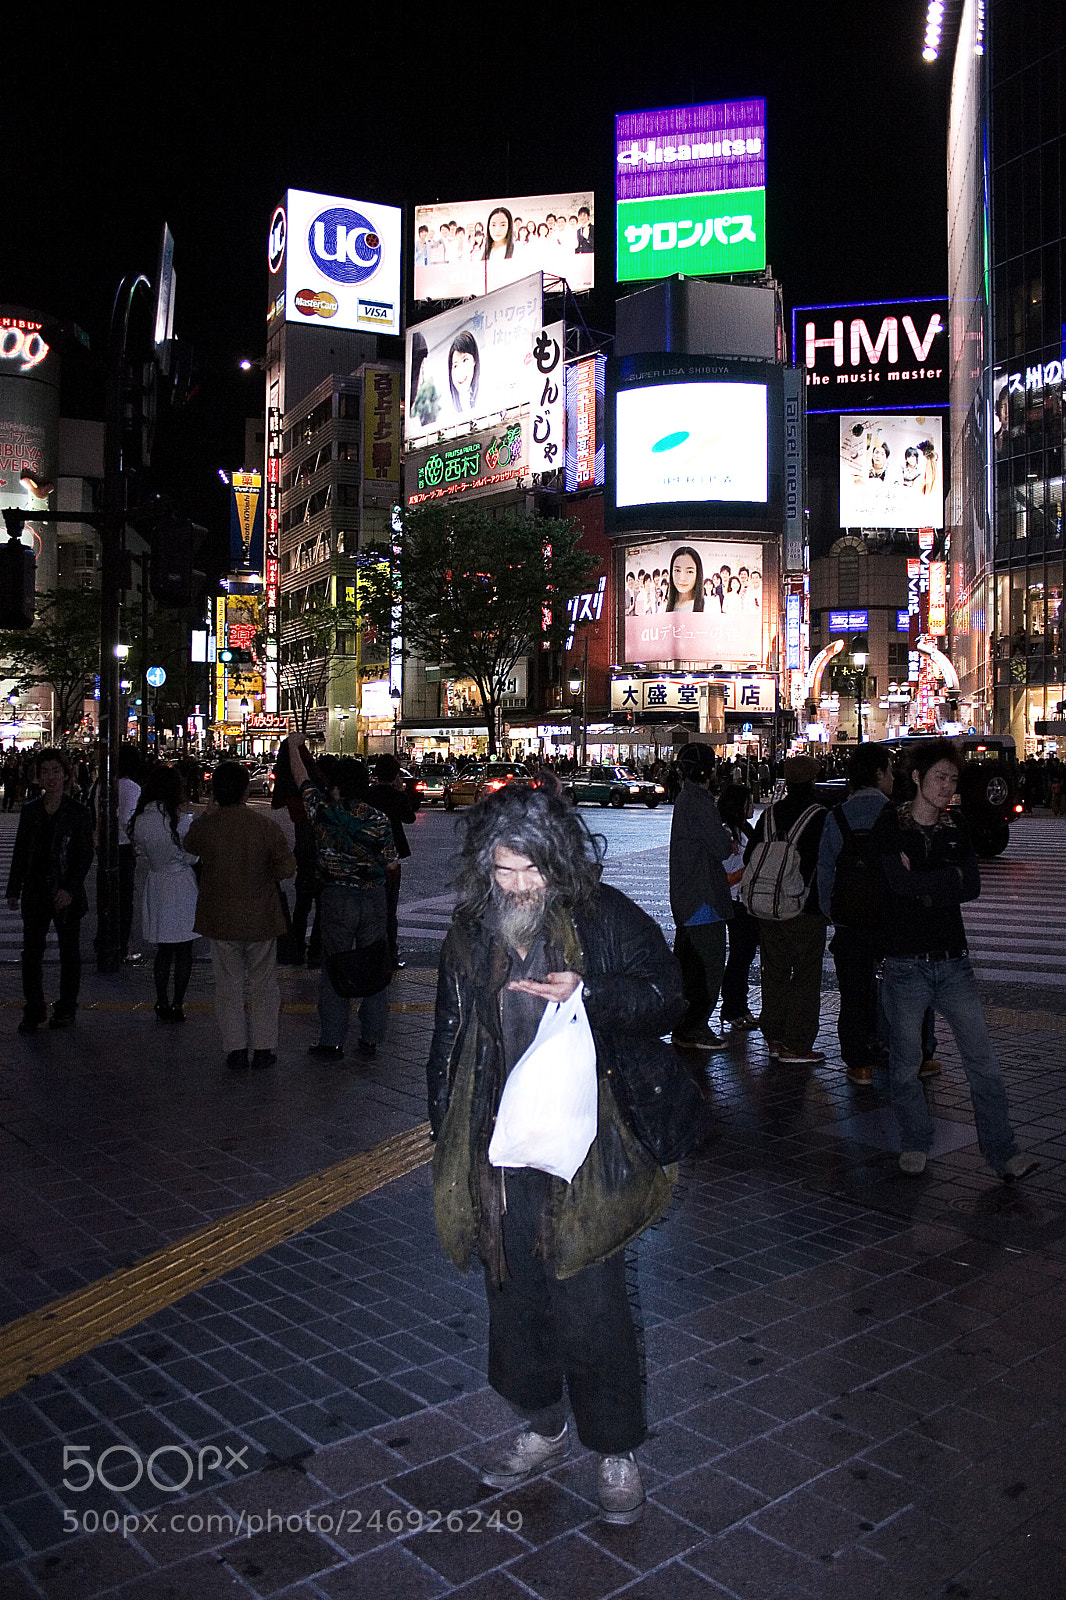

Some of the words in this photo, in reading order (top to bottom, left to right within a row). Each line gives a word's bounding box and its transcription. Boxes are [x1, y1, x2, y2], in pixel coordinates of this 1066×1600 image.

[624, 214, 757, 253] サロンパス
[295, 296, 338, 311] MasterCard
[364, 306, 388, 318] VISA
[804, 313, 941, 368] HMV
[629, 370, 660, 381] SUPER
[662, 367, 686, 377] LISA
[688, 366, 729, 374] SHIBUYA
[805, 371, 830, 386] the
[836, 370, 881, 384] music
[886, 367, 943, 382] master
[532, 330, 561, 464] もんじゃ
[786, 392, 800, 458] Taisei
[445, 452, 480, 482] 西村
[786, 464, 798, 519] neon
